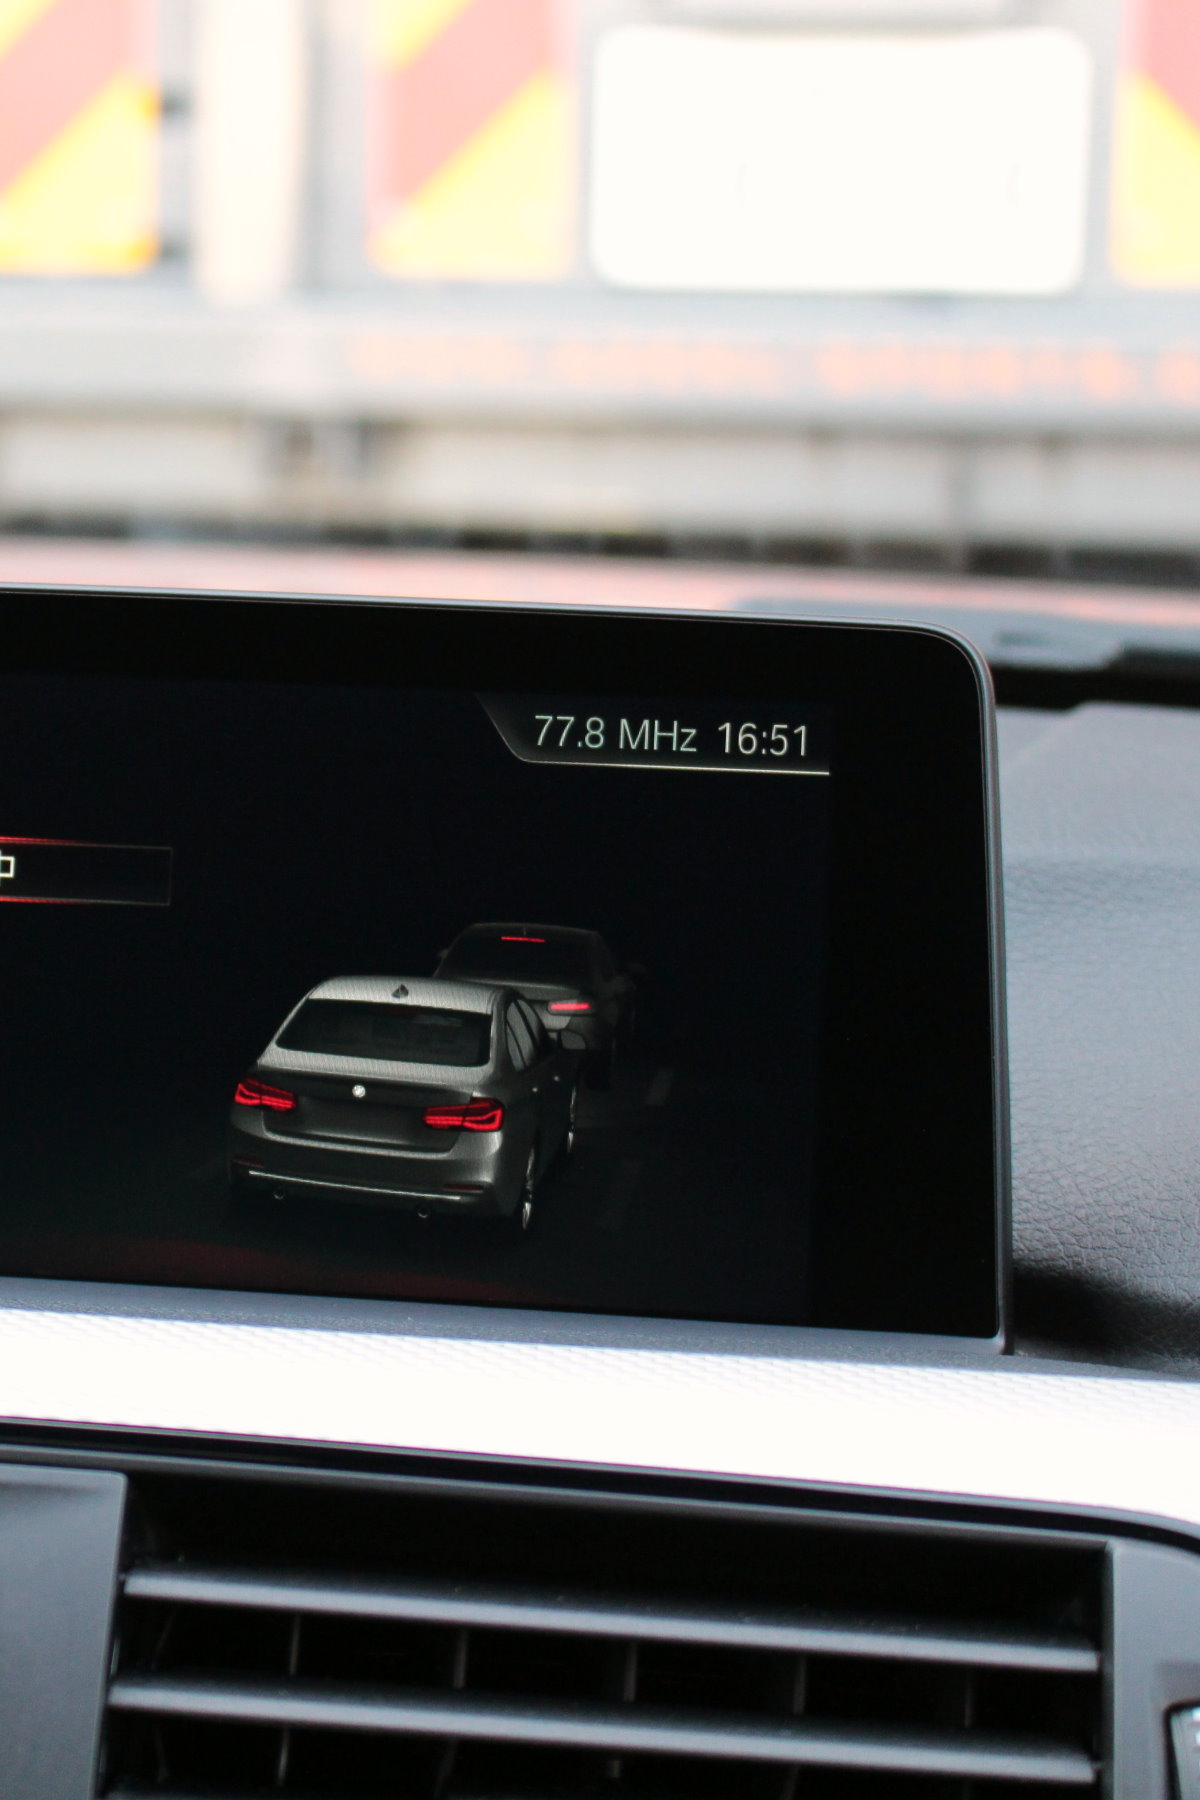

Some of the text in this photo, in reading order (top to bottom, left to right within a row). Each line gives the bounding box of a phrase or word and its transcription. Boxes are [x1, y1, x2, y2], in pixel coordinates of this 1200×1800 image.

[534, 715, 808, 756] 77.8 MHz 16:51
